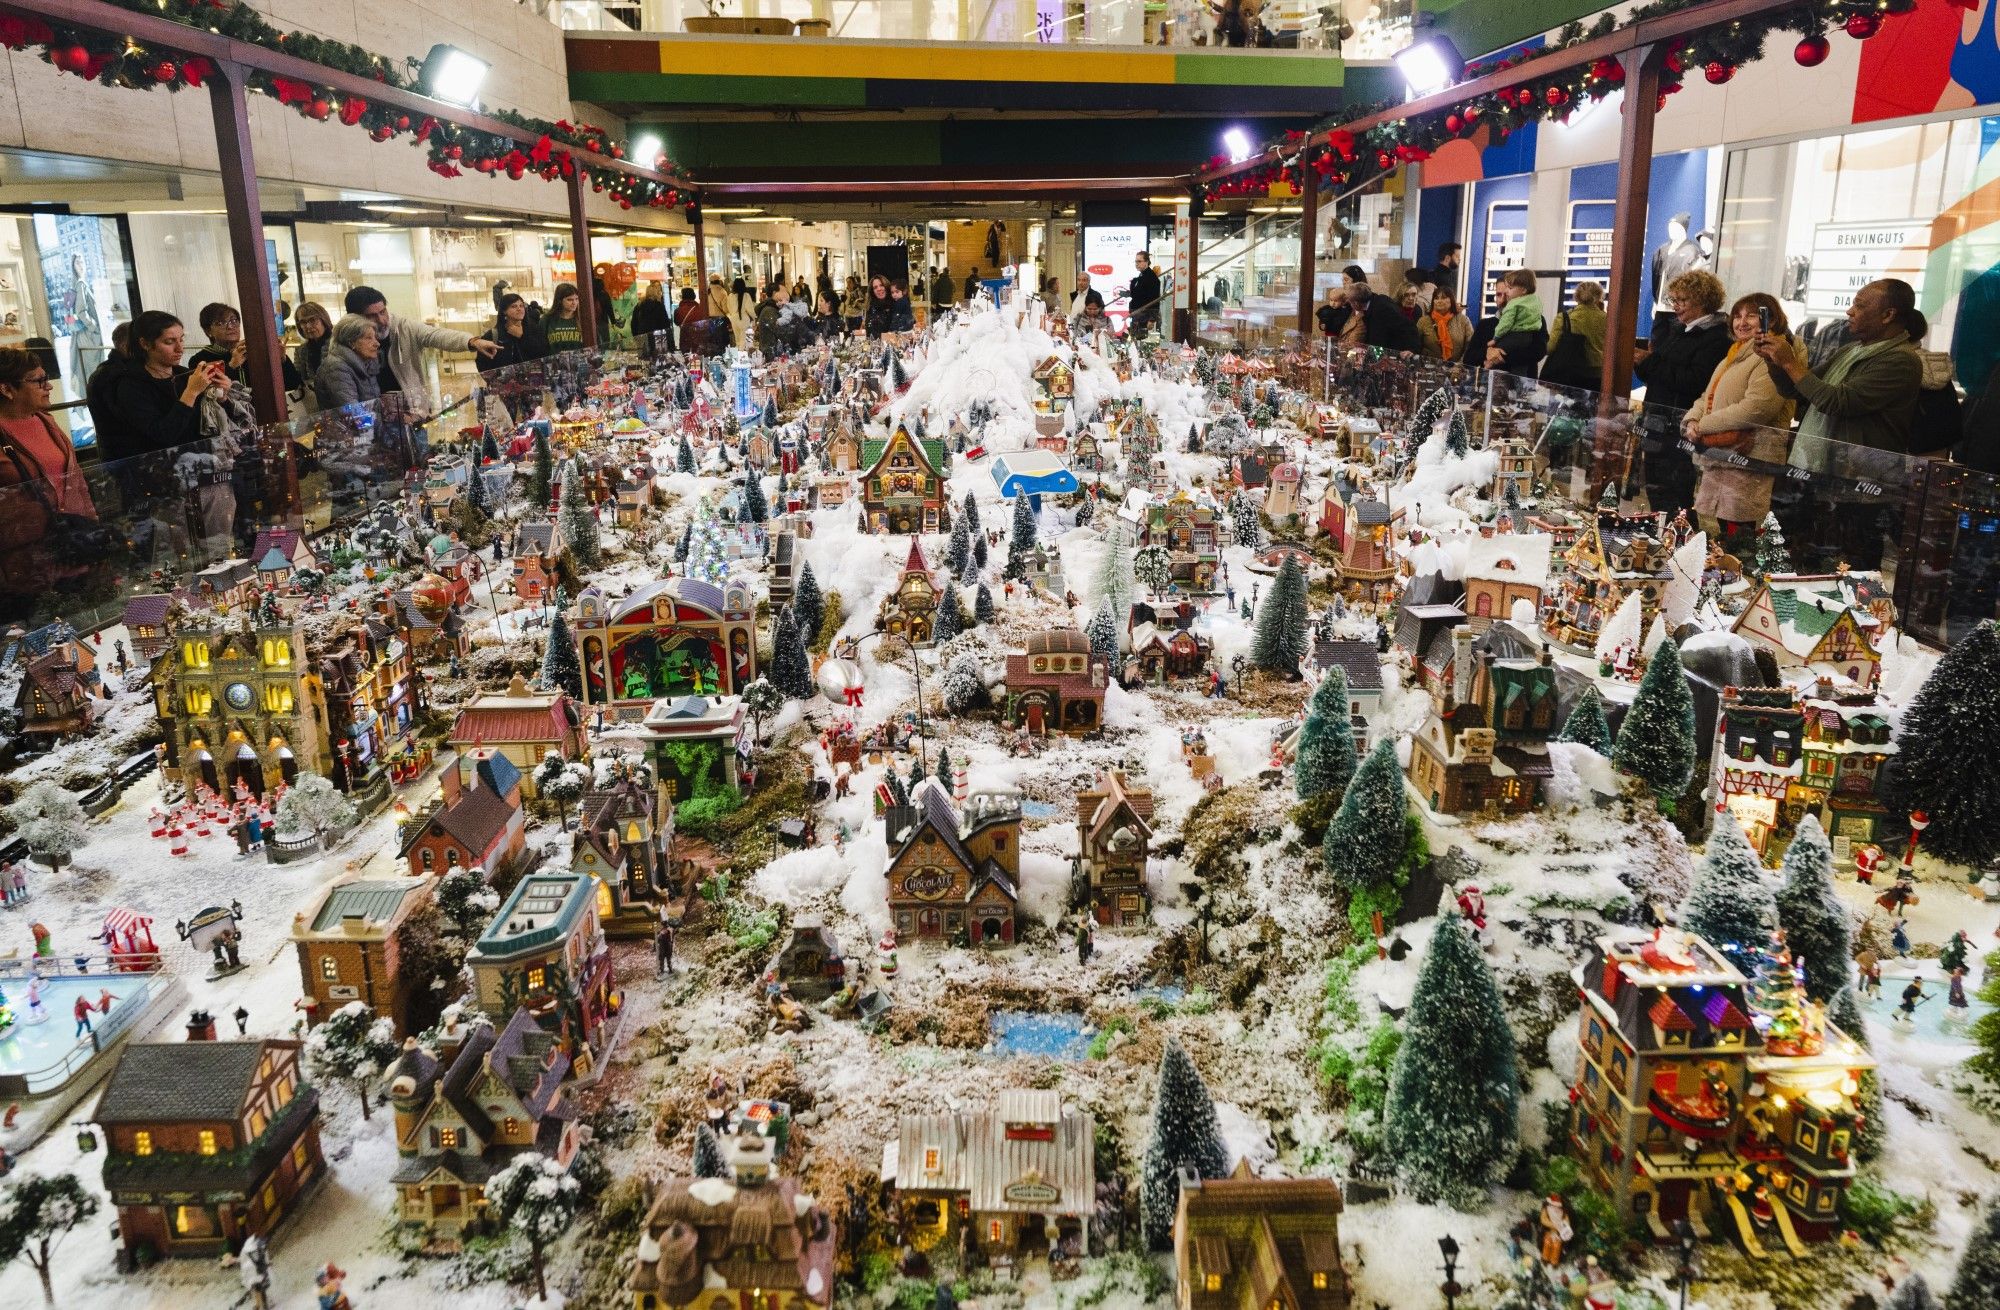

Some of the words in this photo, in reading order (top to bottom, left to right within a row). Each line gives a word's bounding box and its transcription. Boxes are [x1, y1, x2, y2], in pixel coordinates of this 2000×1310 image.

[1837, 232, 1905, 245] BENVINGUTS
[1860, 255, 1867, 265] A
[1834, 296, 1851, 306] DIA
[548, 331, 583, 344] OGWAR
[213, 472, 233, 484] L'illa
[1786, 467, 1811, 481] L'illa
[1854, 480, 1882, 496] L'illa
